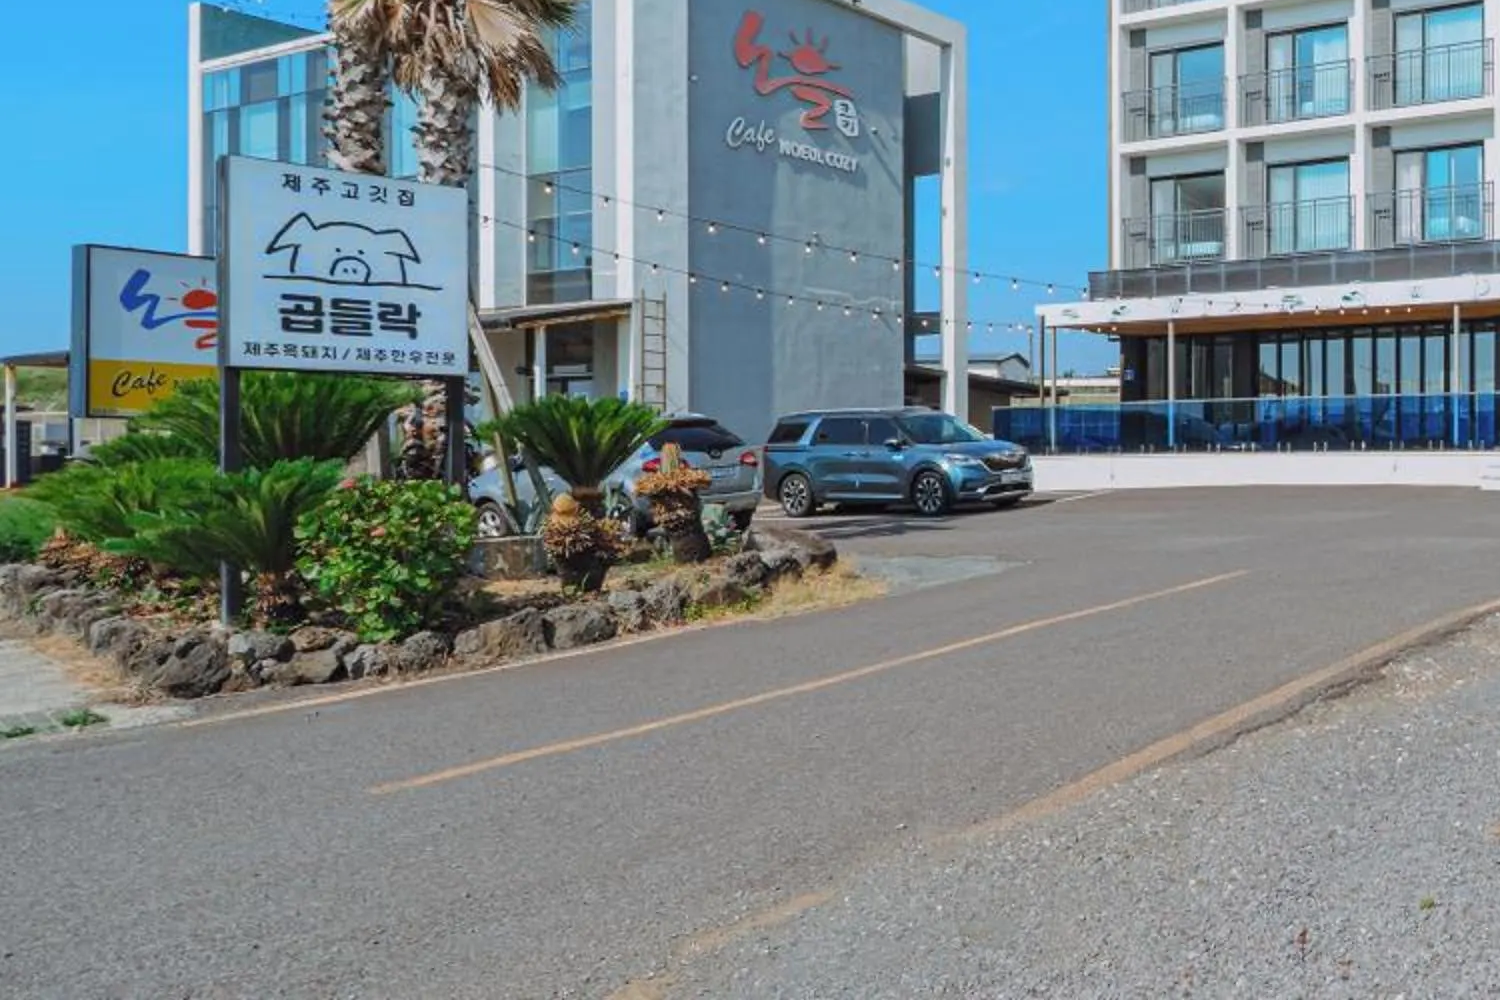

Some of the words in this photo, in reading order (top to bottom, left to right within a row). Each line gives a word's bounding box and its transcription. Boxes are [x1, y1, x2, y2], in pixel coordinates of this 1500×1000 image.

[726, 116, 775, 152] Cafe
[281, 172, 416, 207] 제주고깃집
[278, 292, 422, 341] 곱들락
[112, 367, 168, 397] Cafe
